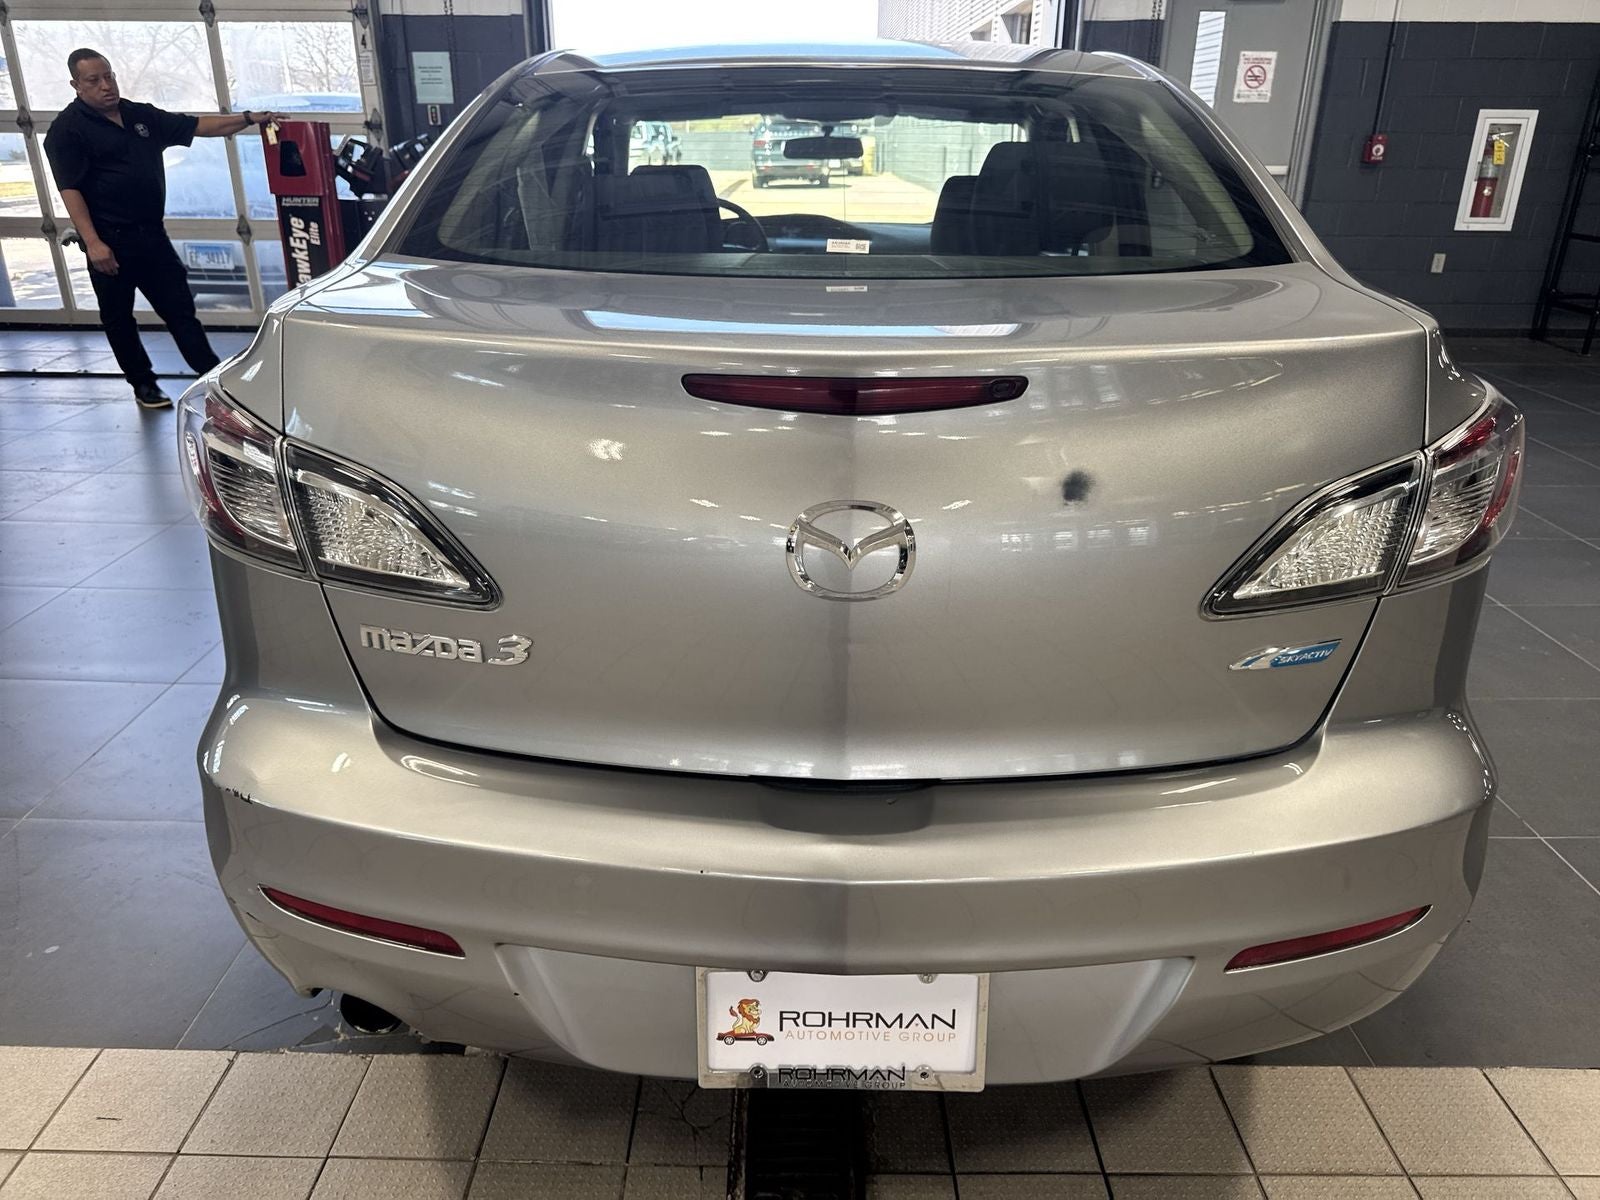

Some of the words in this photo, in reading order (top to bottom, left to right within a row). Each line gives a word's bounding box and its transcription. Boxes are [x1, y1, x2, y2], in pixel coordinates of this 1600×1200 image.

[361, 34, 367, 49] 4
[309, 221, 321, 246] Elite
[487, 634, 533, 666] 3
[1279, 649, 1333, 664] SKYACTIV
[779, 1009, 956, 1032] ROHRMAN
[785, 1030, 891, 1042] AUTOMOTIVE
[899, 1032, 956, 1042] GROUP
[778, 1065, 906, 1083] ROHRMAN
[864, 1080, 906, 1089] GROUP
